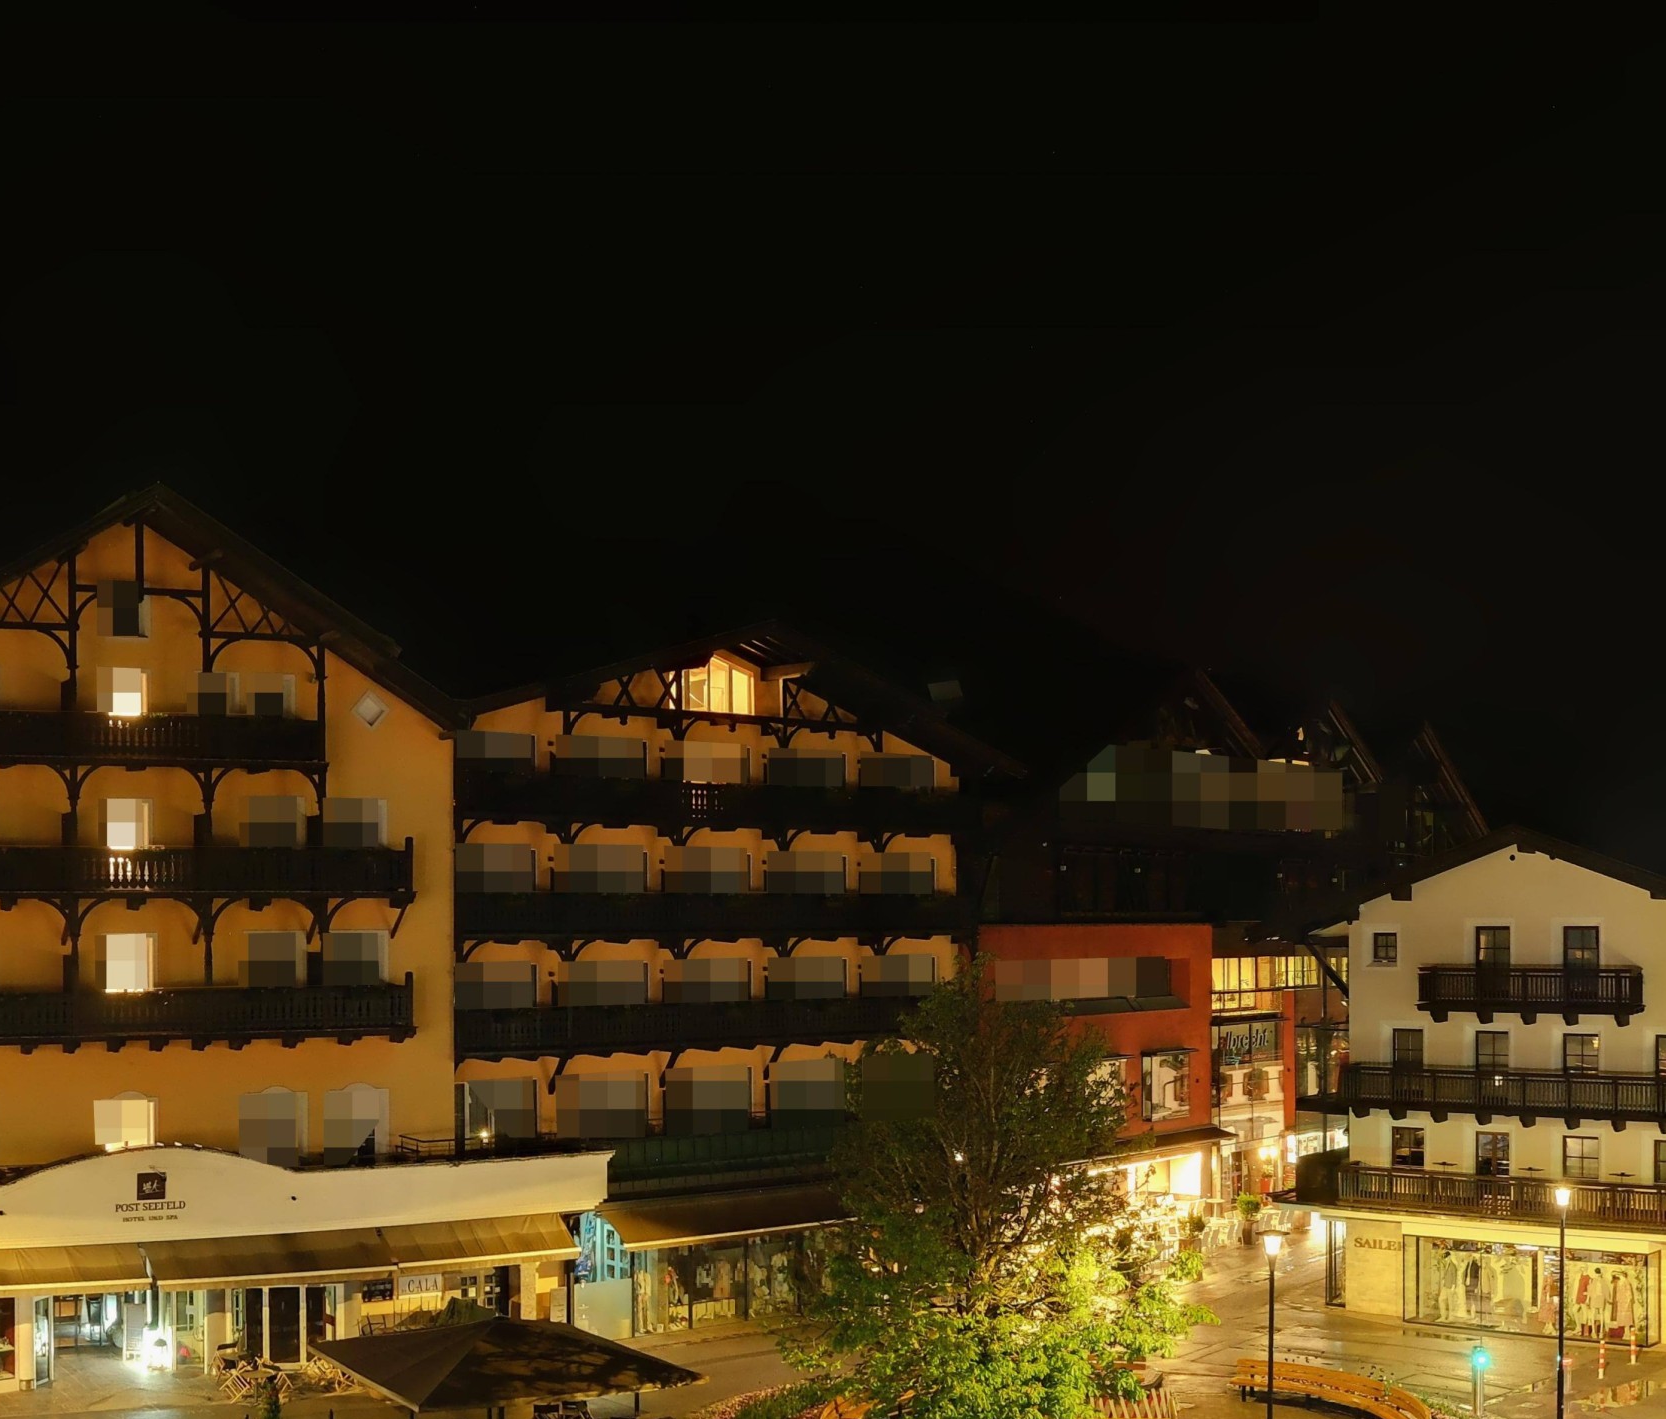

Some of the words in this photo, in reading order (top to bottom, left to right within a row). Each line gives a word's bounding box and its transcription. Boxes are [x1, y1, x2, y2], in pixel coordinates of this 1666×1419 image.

[115, 1203, 141, 1212] POST
[142, 1200, 186, 1211] SEEFELD
[407, 1276, 439, 1293] CALA
